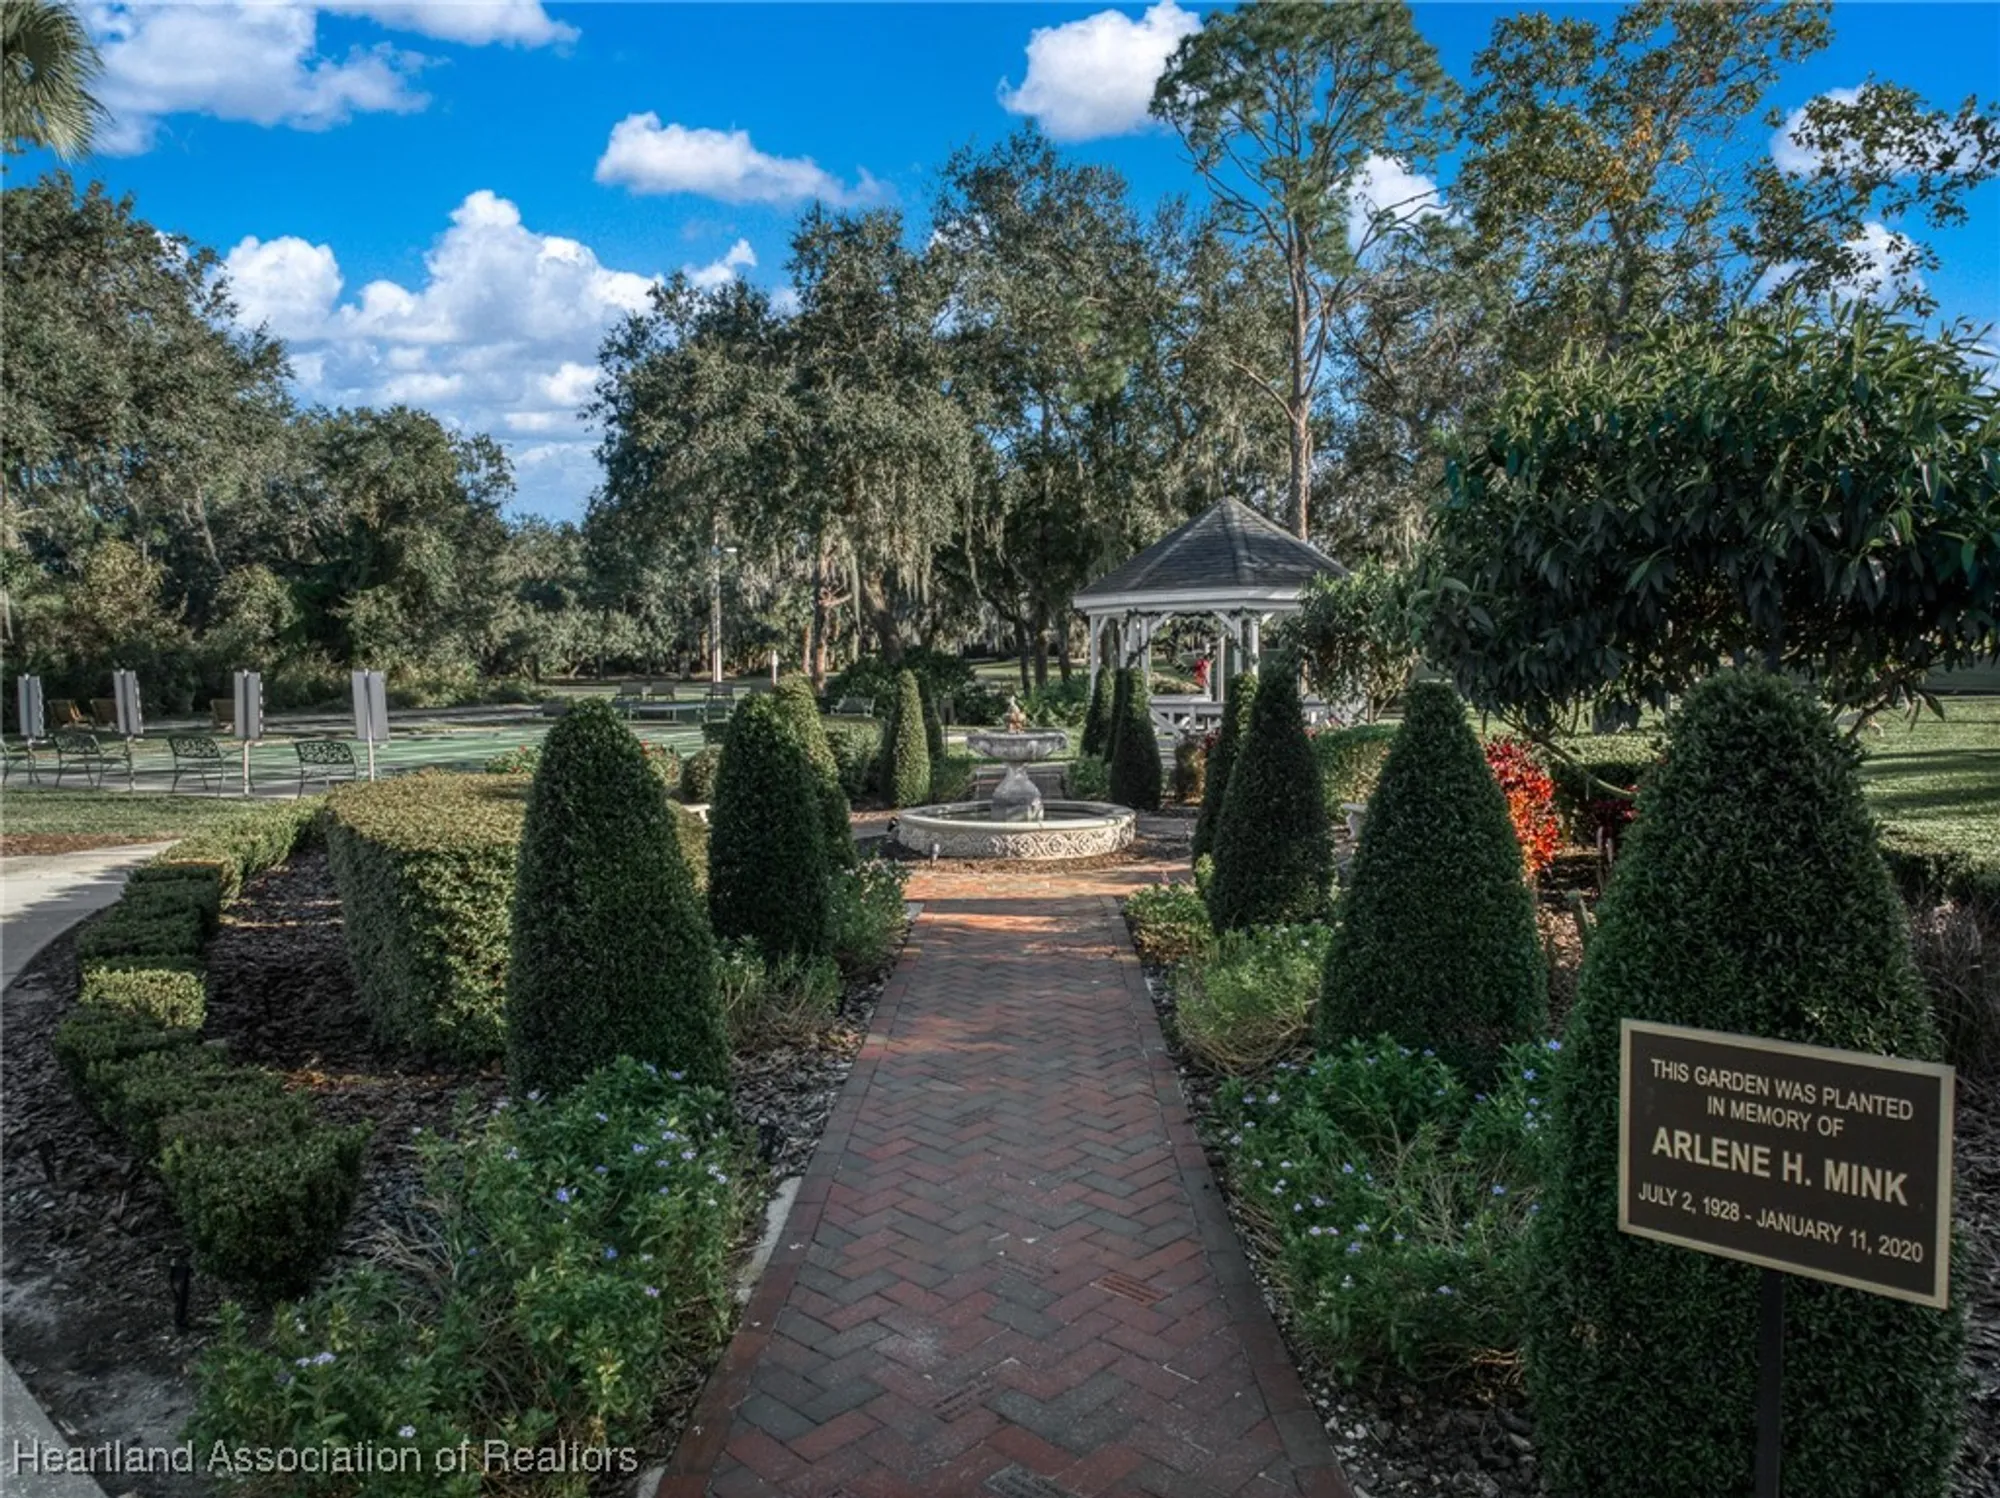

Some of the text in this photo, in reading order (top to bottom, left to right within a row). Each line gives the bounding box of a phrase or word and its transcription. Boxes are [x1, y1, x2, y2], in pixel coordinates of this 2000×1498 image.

[1651, 1058, 1913, 1120] THIS GARDEN WAS PLANTED
[1707, 1096, 1843, 1137] IN MEMORY OF
[1652, 1127, 1908, 1206] ARLENE H. MINK
[1638, 1183, 1677, 1207] JULY
[1681, 1192, 1695, 1214] 2,
[1703, 1196, 1739, 1221] 1928
[1756, 1209, 1842, 1244] JANUARY
[1850, 1230, 1871, 1253] 11,
[1879, 1236, 1923, 1262] 2020
